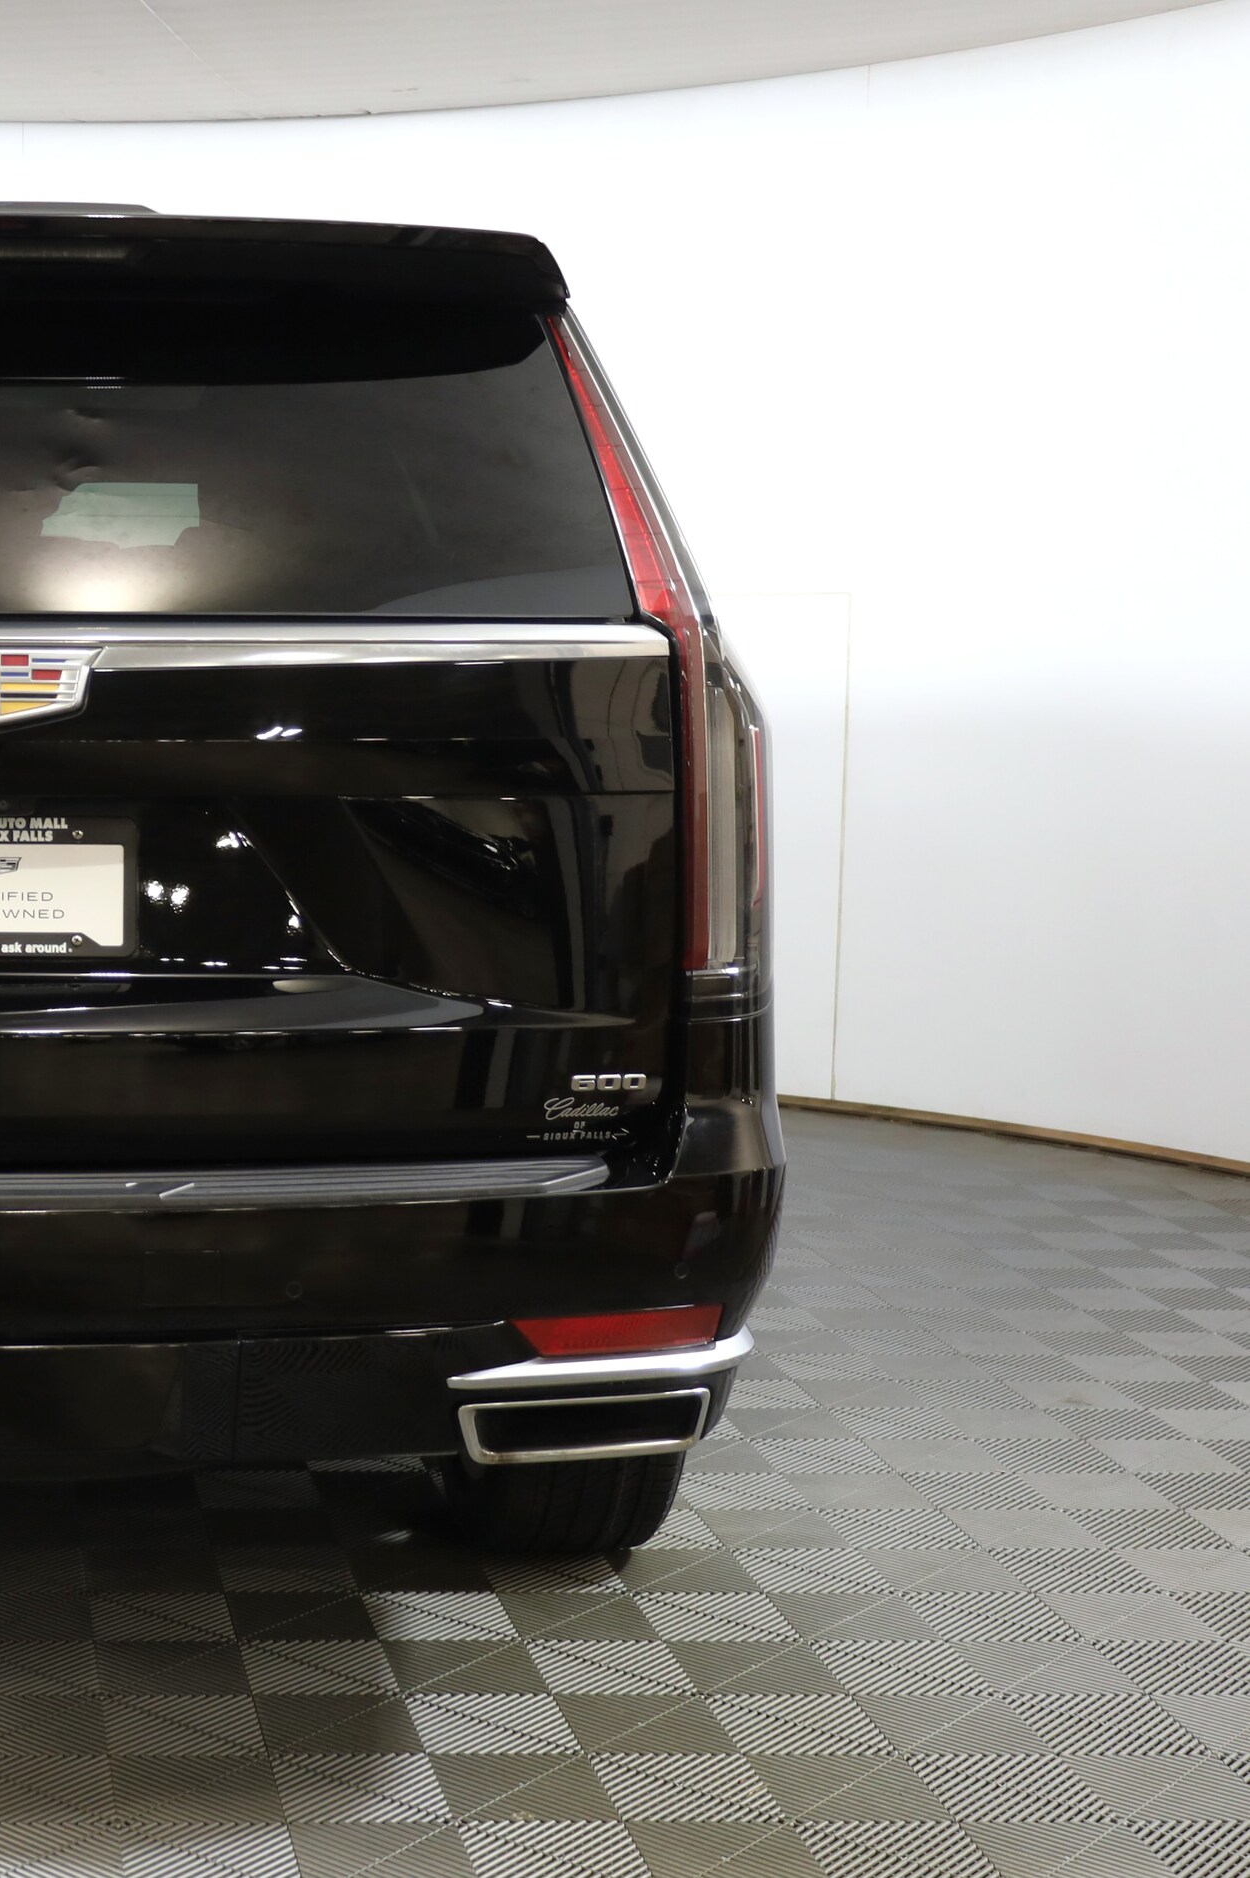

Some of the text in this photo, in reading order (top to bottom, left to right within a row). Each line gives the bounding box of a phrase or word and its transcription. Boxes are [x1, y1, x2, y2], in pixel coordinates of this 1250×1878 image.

[30, 817, 68, 829] MALL
[13, 830, 54, 842] FALLS
[1, 941, 22, 954] ask
[571, 1073, 647, 1091] 600
[543, 1097, 619, 1120] Cadillac
[573, 1121, 586, 1129] OF
[543, 1131, 611, 1141] SIOUX FALLS
